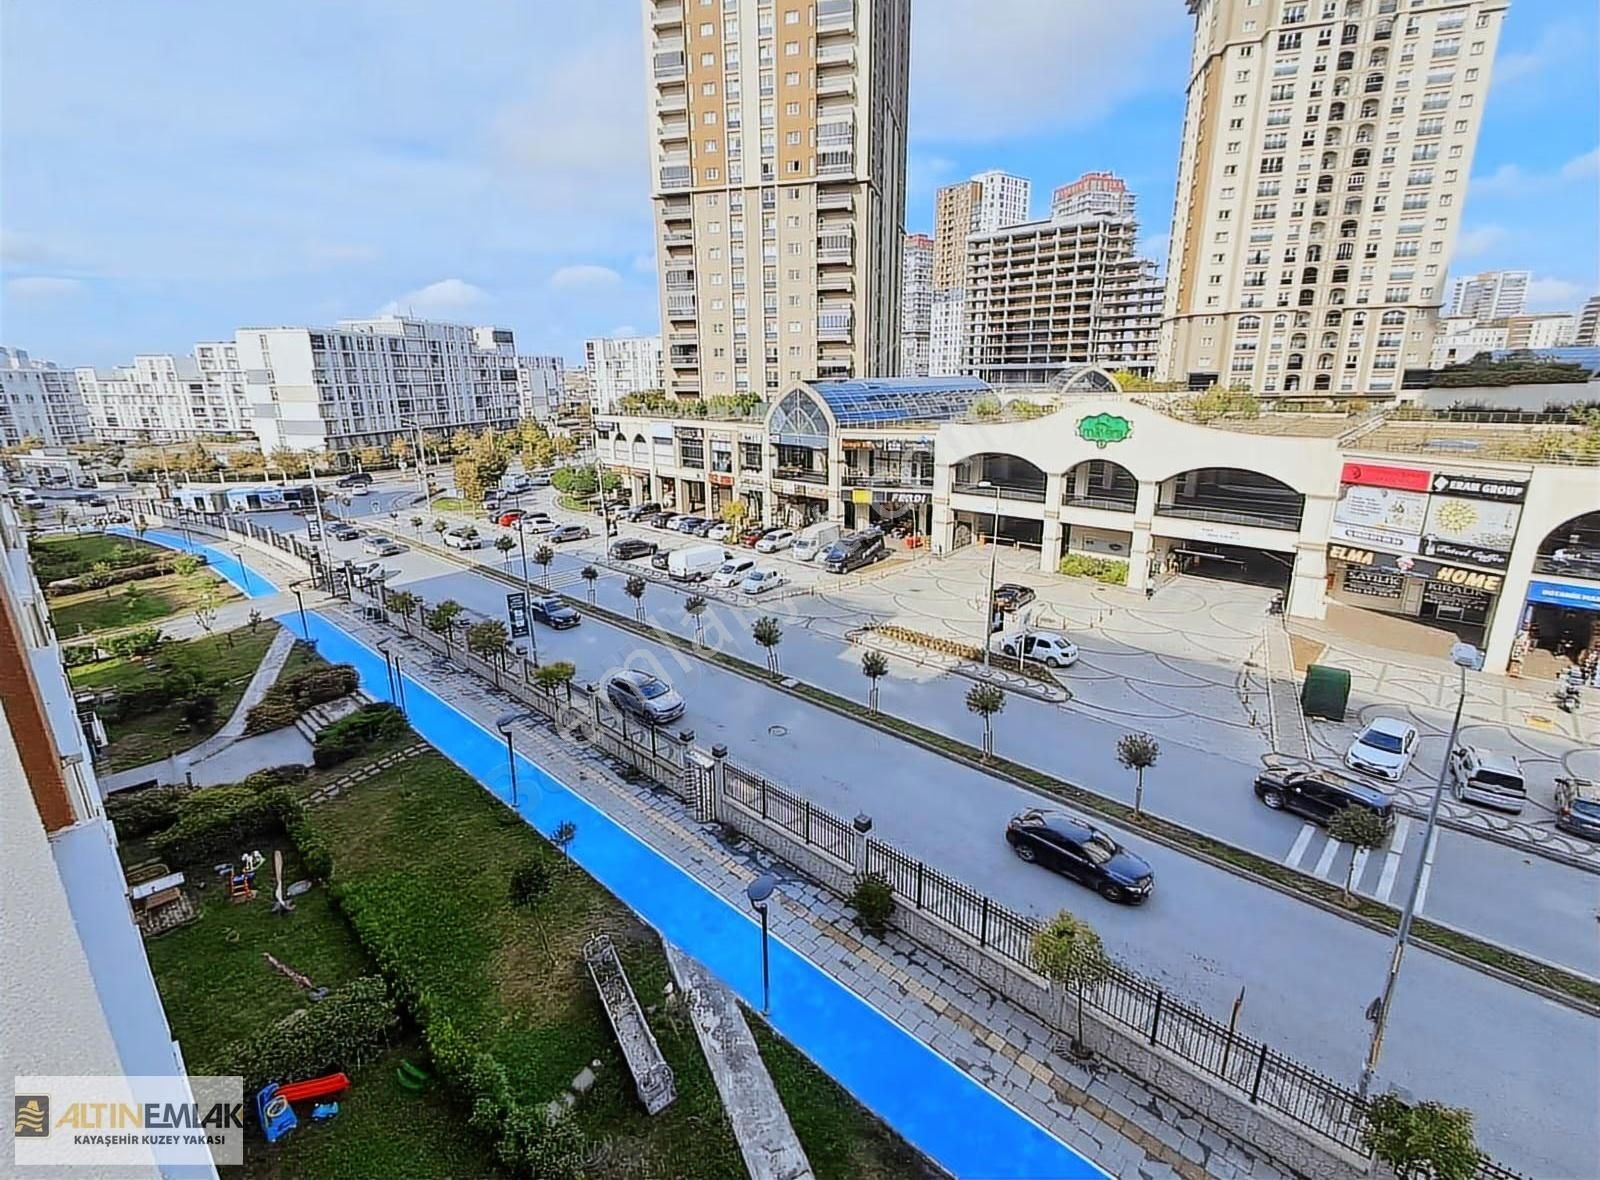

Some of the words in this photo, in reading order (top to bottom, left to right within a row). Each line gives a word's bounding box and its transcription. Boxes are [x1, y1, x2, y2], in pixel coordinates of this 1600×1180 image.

[1481, 483, 1523, 496] GROUP
[1330, 546, 1374, 565] ELMA
[1437, 566, 1500, 592] HOME
